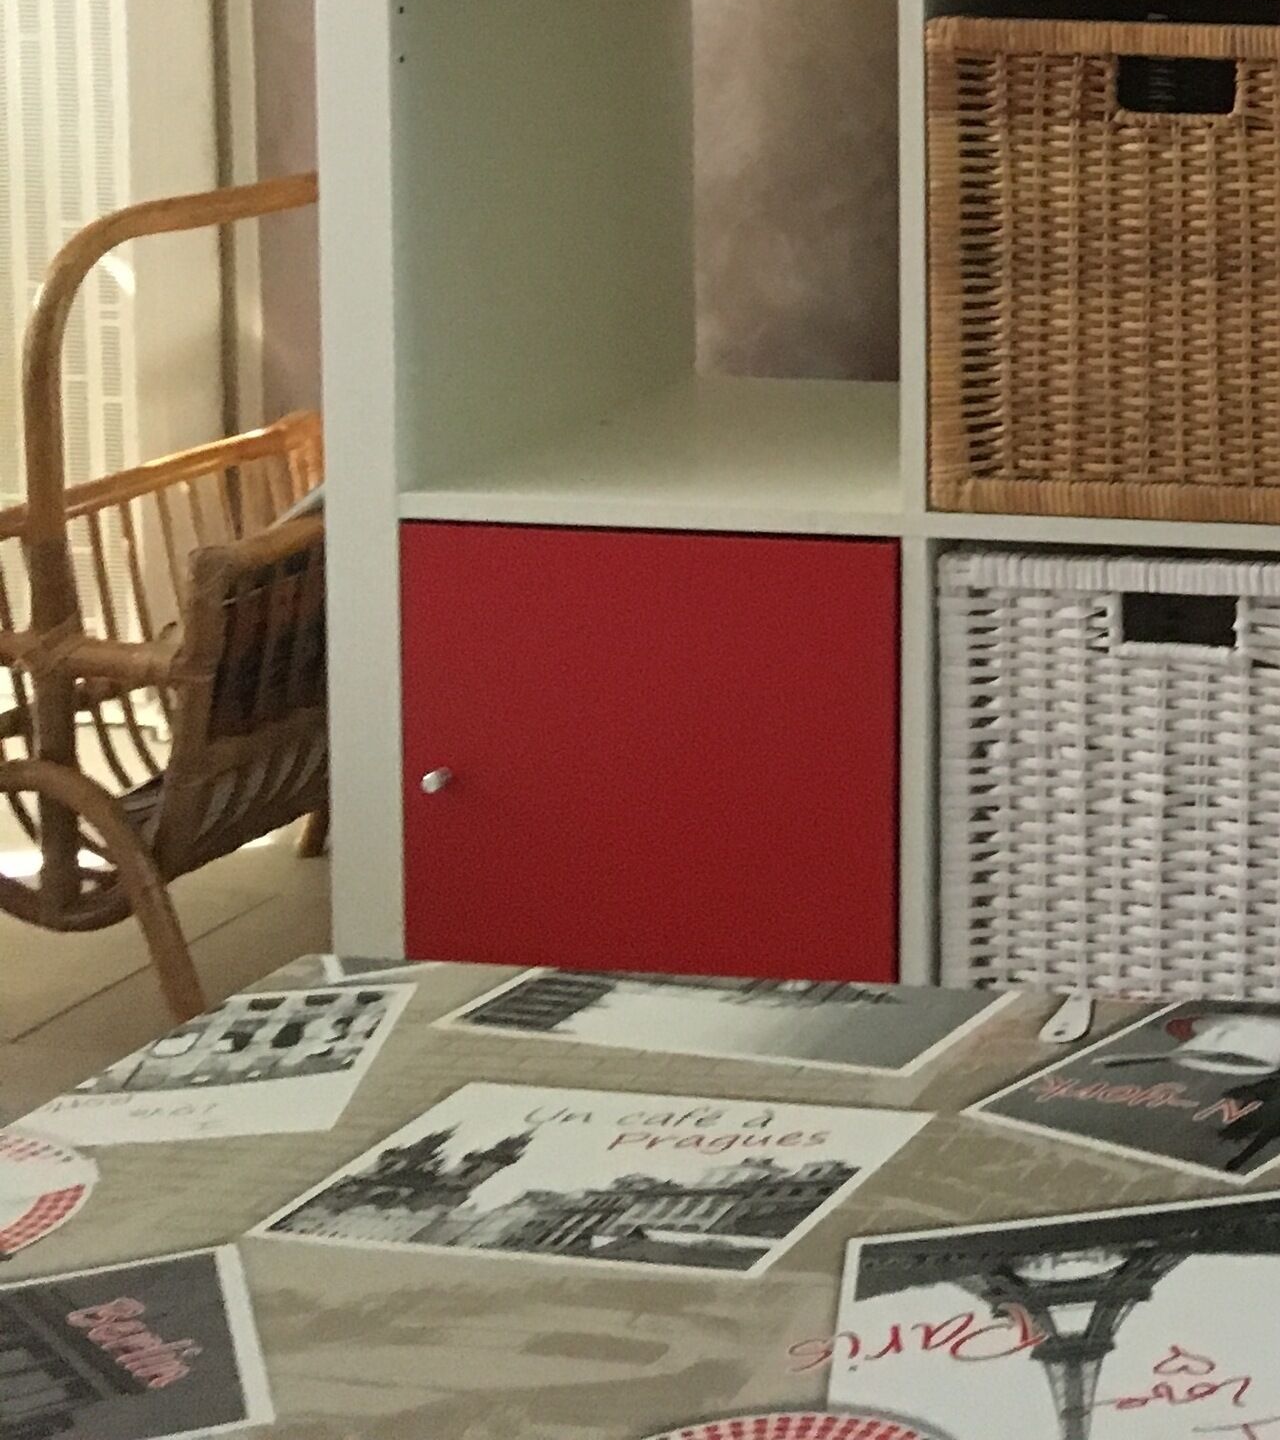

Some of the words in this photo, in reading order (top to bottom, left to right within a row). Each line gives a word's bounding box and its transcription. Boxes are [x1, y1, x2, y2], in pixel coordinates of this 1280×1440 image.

[523, 1106, 593, 1123] Un
[607, 1130, 831, 1156] Pragues
[788, 1302, 1049, 1373] Paris
